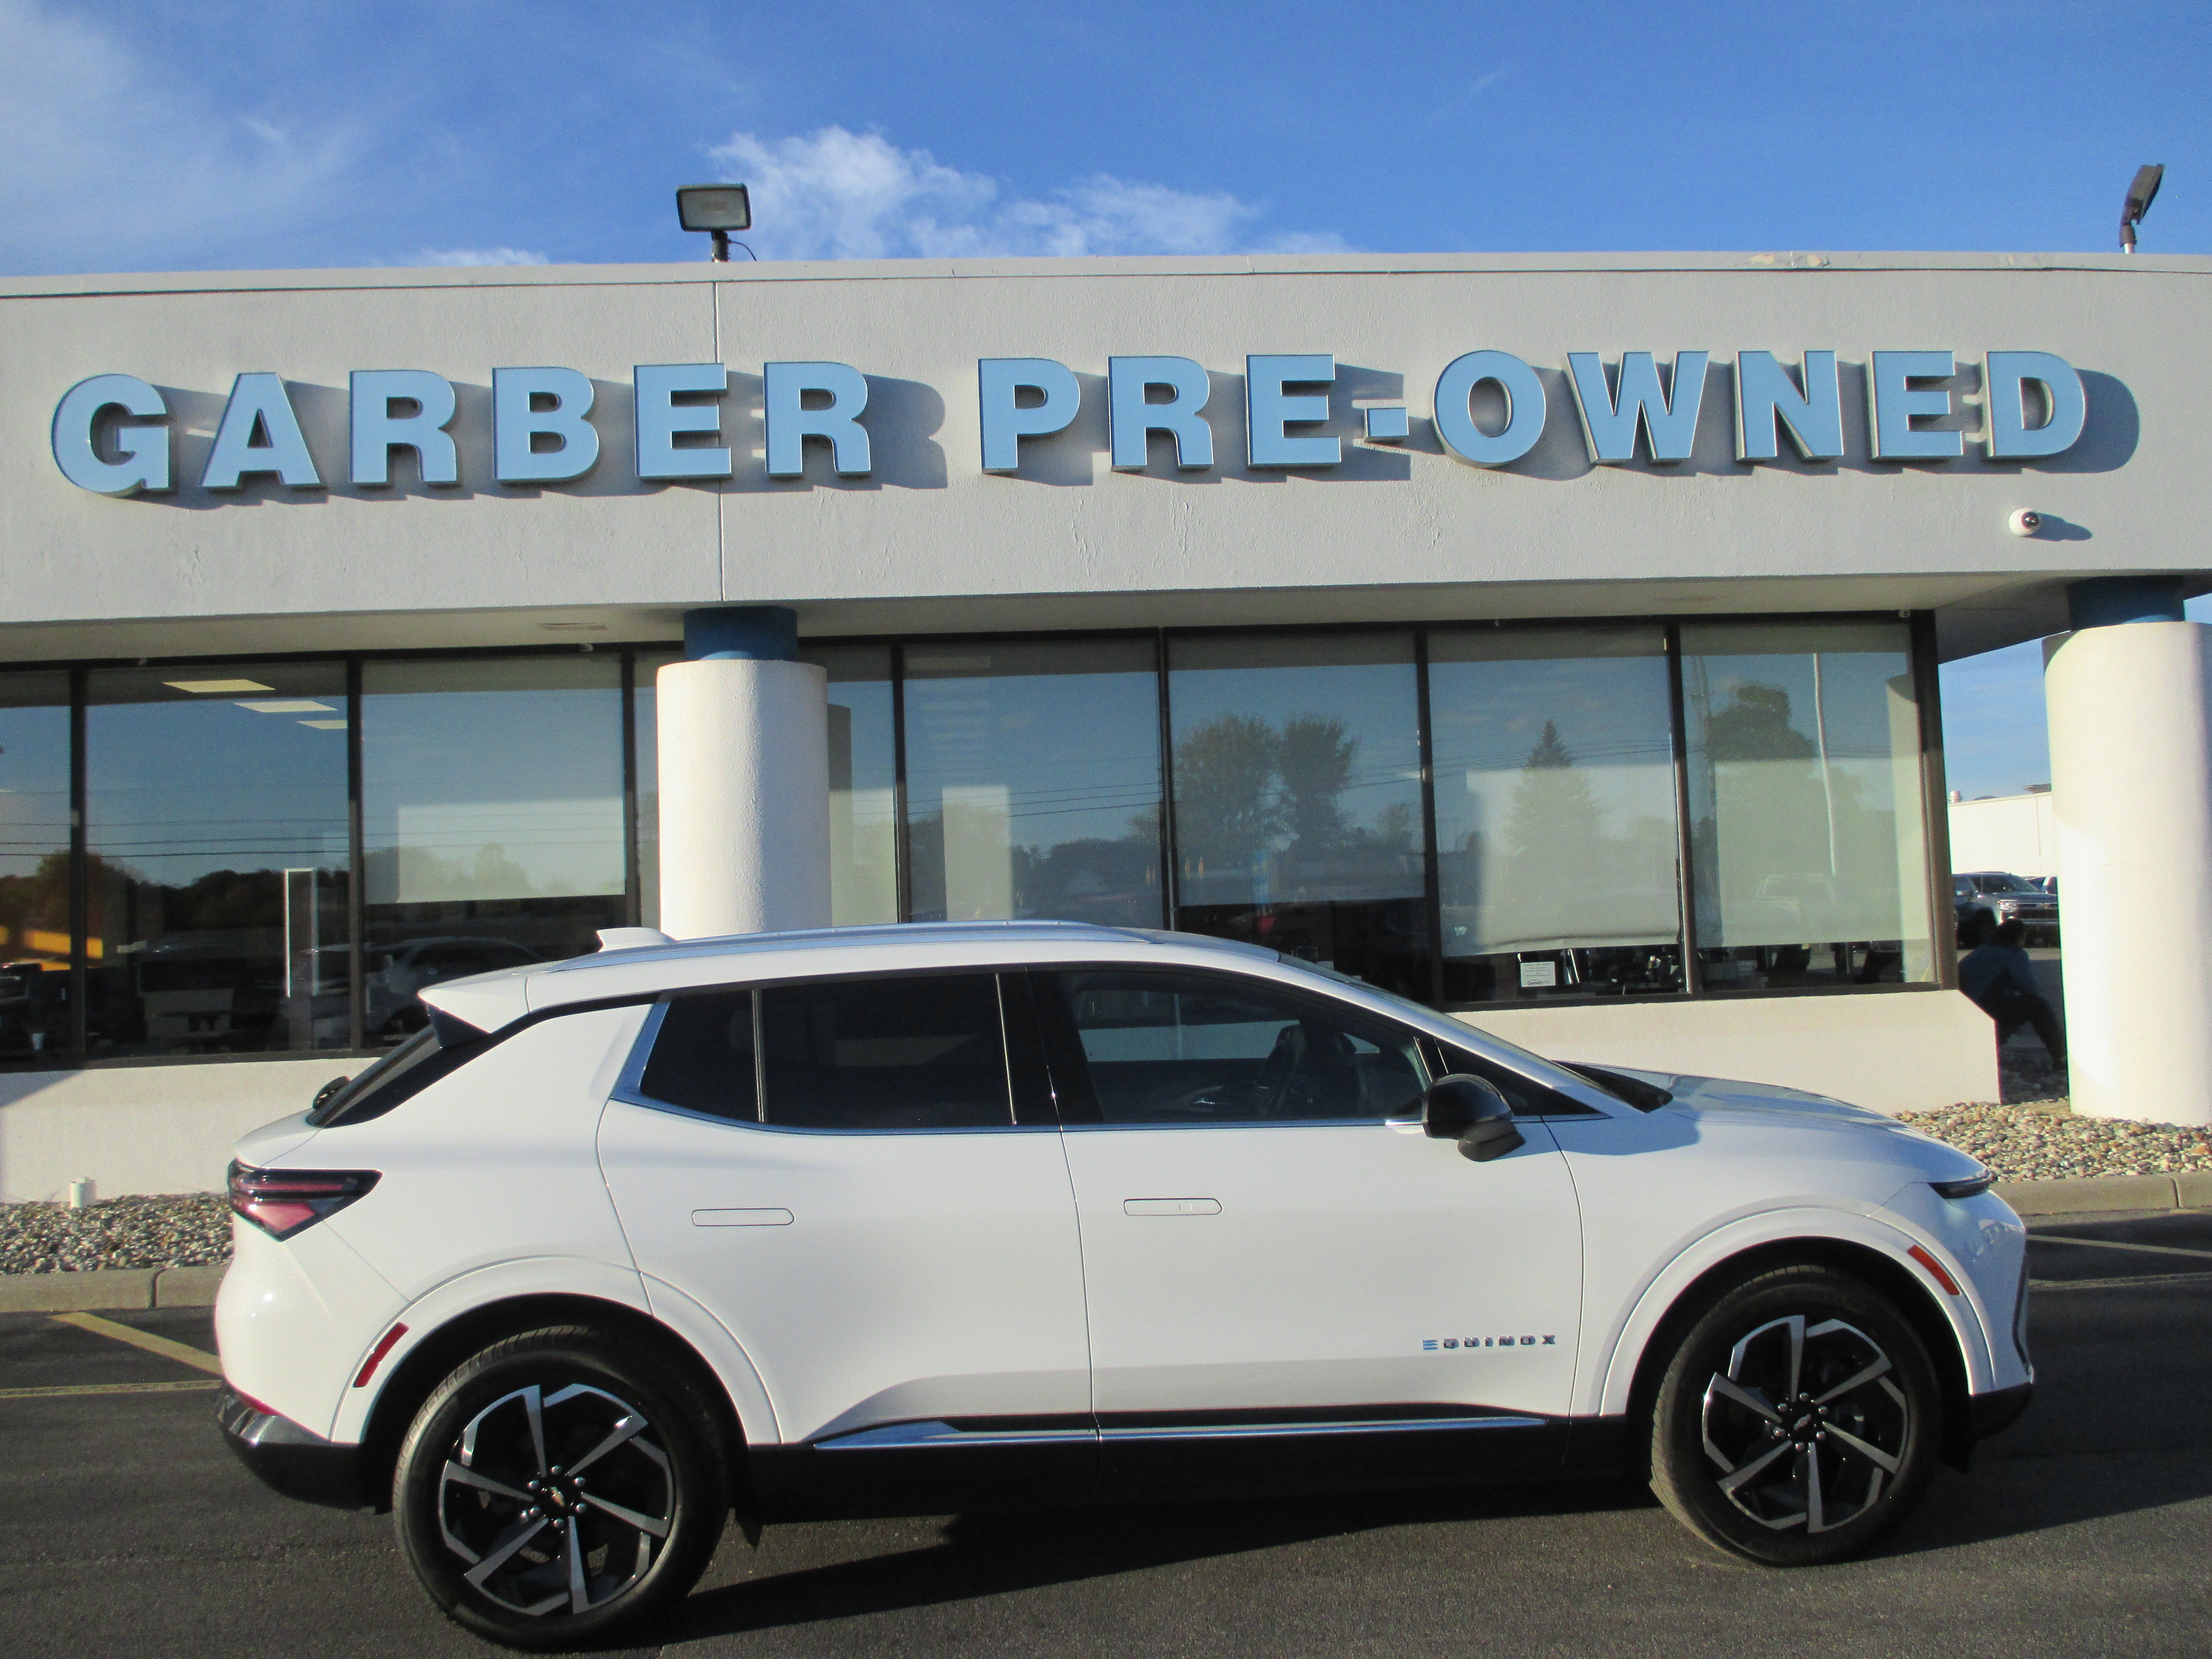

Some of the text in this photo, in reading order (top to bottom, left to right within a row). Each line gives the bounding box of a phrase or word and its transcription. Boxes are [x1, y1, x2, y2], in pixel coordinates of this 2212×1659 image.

[51, 350, 2088, 495] GARBER PRE-OWNED
[1422, 1334, 1556, 1350] EQUINOX
